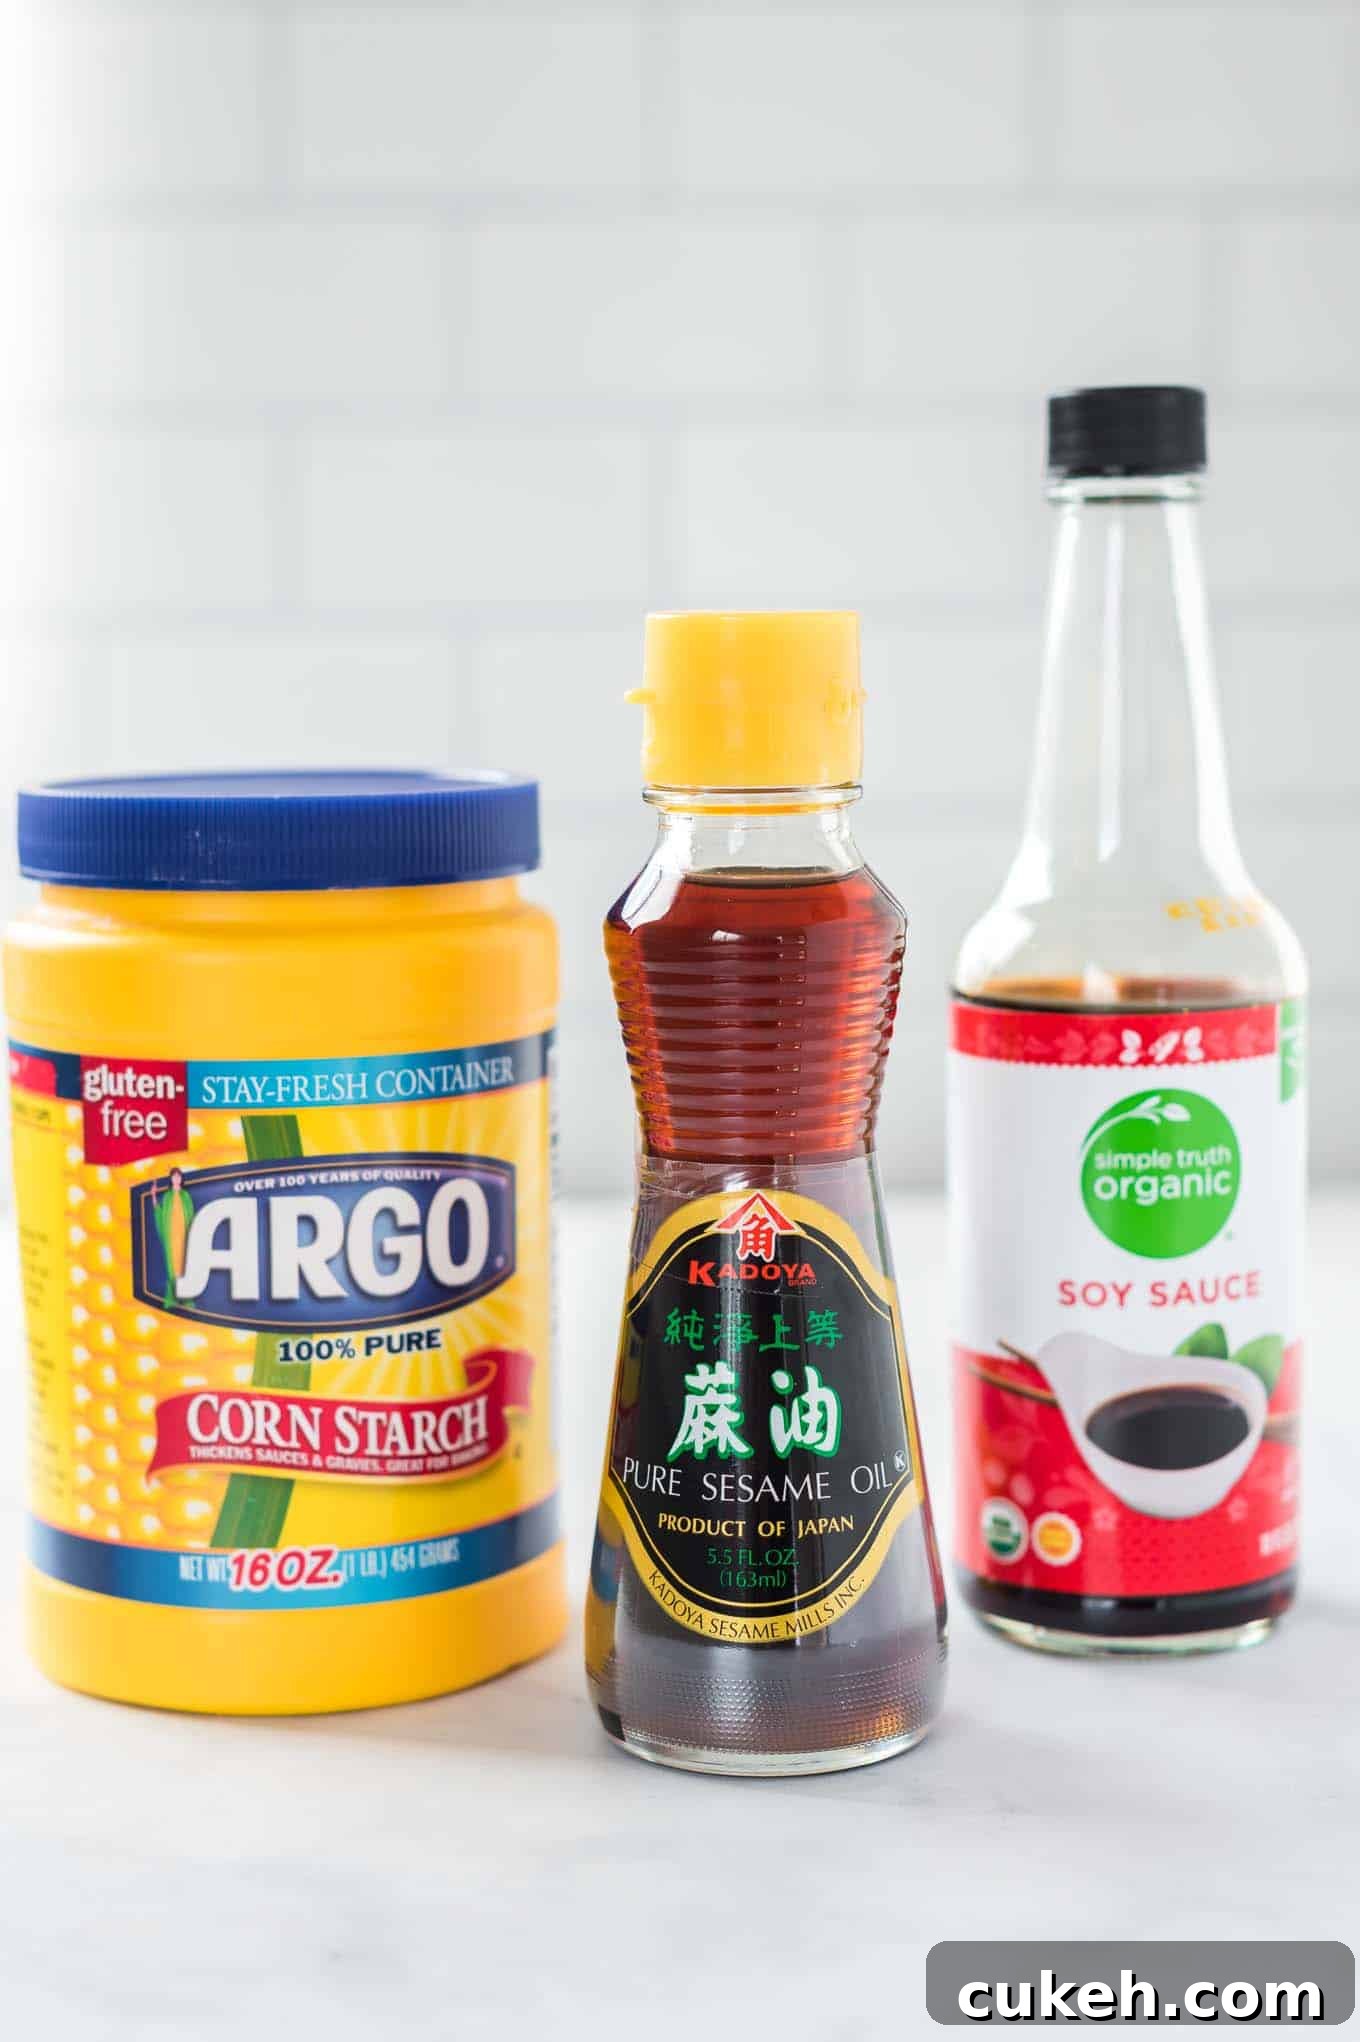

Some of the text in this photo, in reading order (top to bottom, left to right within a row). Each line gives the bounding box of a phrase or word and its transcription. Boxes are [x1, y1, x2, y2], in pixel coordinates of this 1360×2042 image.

[83, 1064, 185, 1102] gluten-
[202, 1056, 515, 1104] STAY-FRESH CONTAINER
[100, 1100, 168, 1140] free
[1093, 1145, 1233, 1174] simple truth
[233, 1168, 441, 1193] OVER 100 YEARS OF QUALITY
[1093, 1167, 1232, 1206] organic
[174, 1177, 490, 1301] ARGO
[737, 1213, 776, 1262] 角
[687, 1260, 816, 1287] KADOYA
[1057, 1268, 1262, 1310] SOY SAUCE
[278, 1328, 442, 1362] 100% PURE
[186, 1393, 489, 1457] CORN STARCH
[189, 1444, 253, 1461] THICKENS
[255, 1448, 308, 1467] SAUCES
[623, 1456, 893, 1503] PURE SESAME OIL
[658, 1512, 855, 1539] PRODUCT OF JAPAN
[179, 1555, 202, 1580] NET
[231, 1552, 270, 1588] 16
[276, 1549, 340, 1588] OZ.
[391, 1545, 415, 1572] 454
[706, 1548, 800, 1567] 5.5 FL. OZ.
[719, 1568, 787, 1588] (163ml)
[648, 1569, 866, 1639] KADOYA SESAME MILLS INC.
